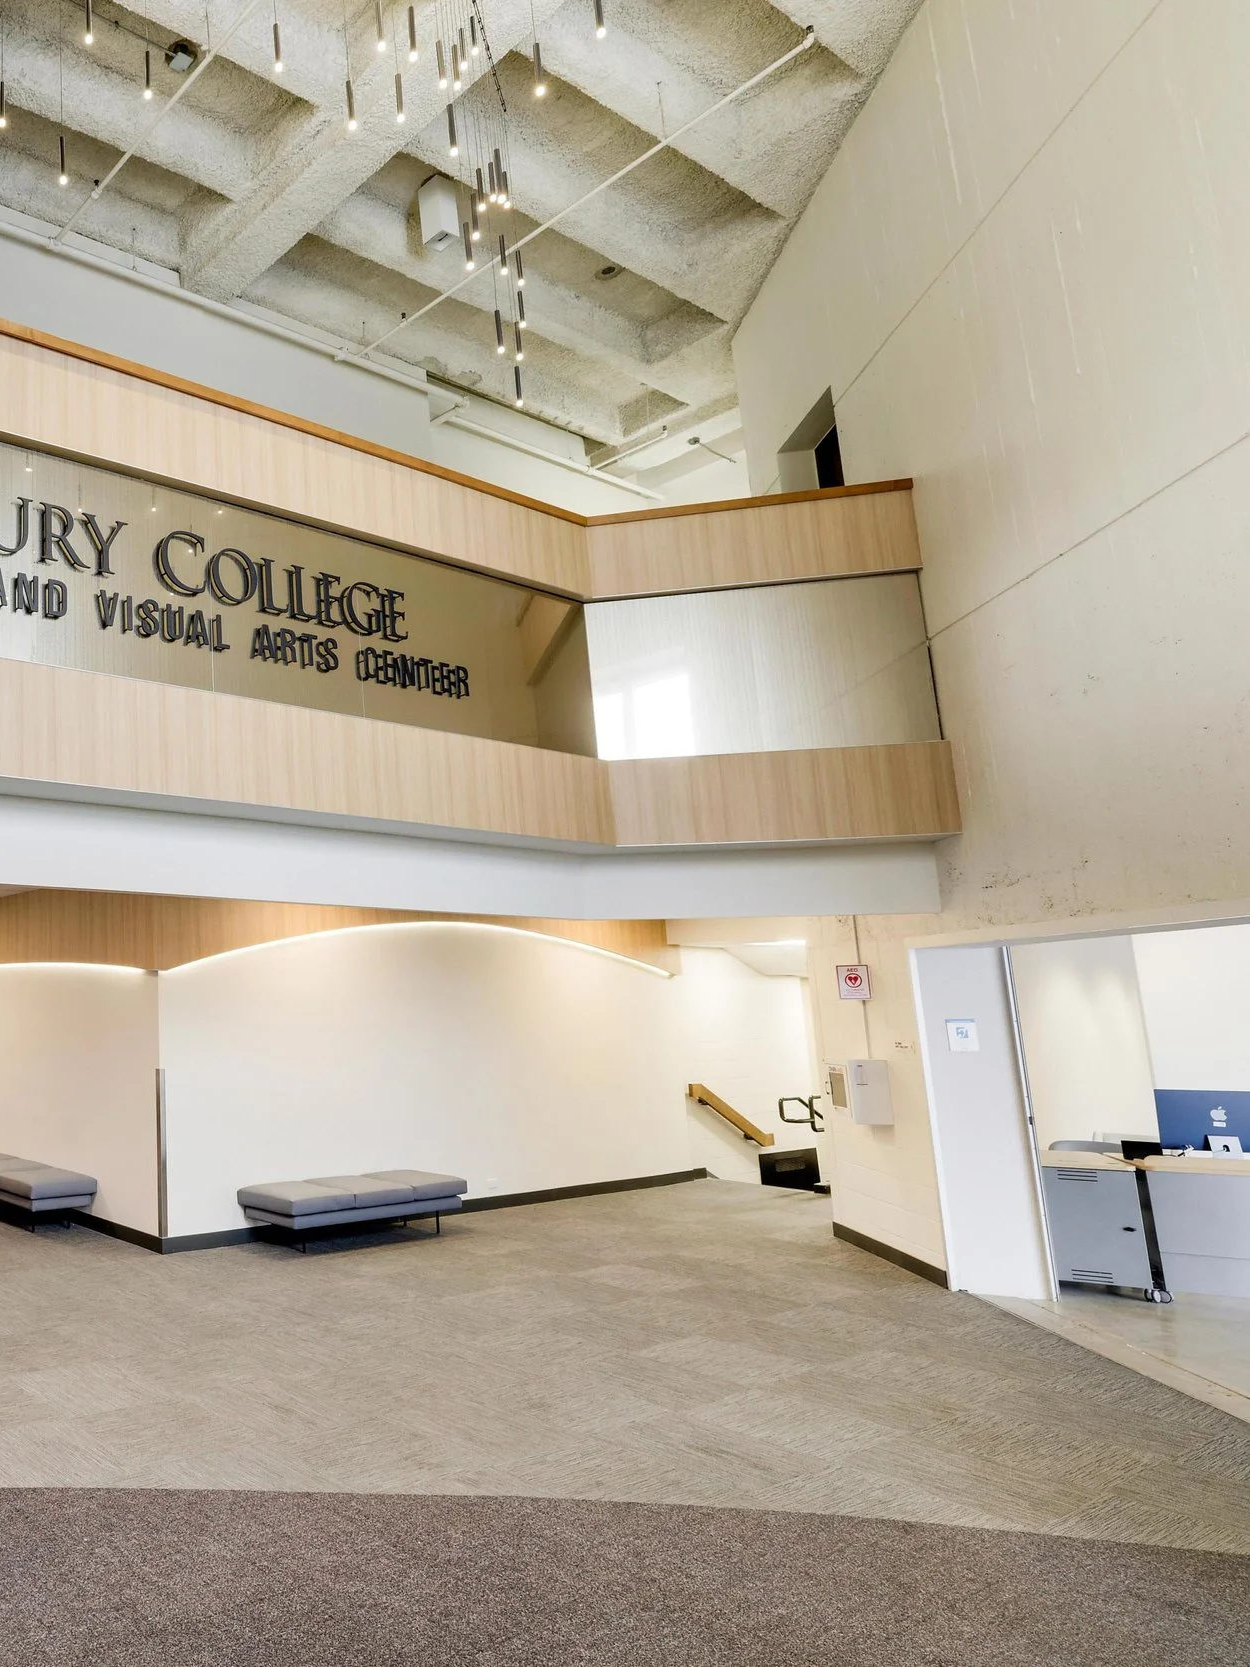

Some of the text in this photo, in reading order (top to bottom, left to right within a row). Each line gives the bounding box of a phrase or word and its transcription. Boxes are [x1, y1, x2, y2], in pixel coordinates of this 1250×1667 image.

[155, 529, 409, 642] COLLEGE
[97, 589, 230, 651] VISUAL
[252, 623, 339, 673] ARTS
[356, 646, 470, 699] CENTER
